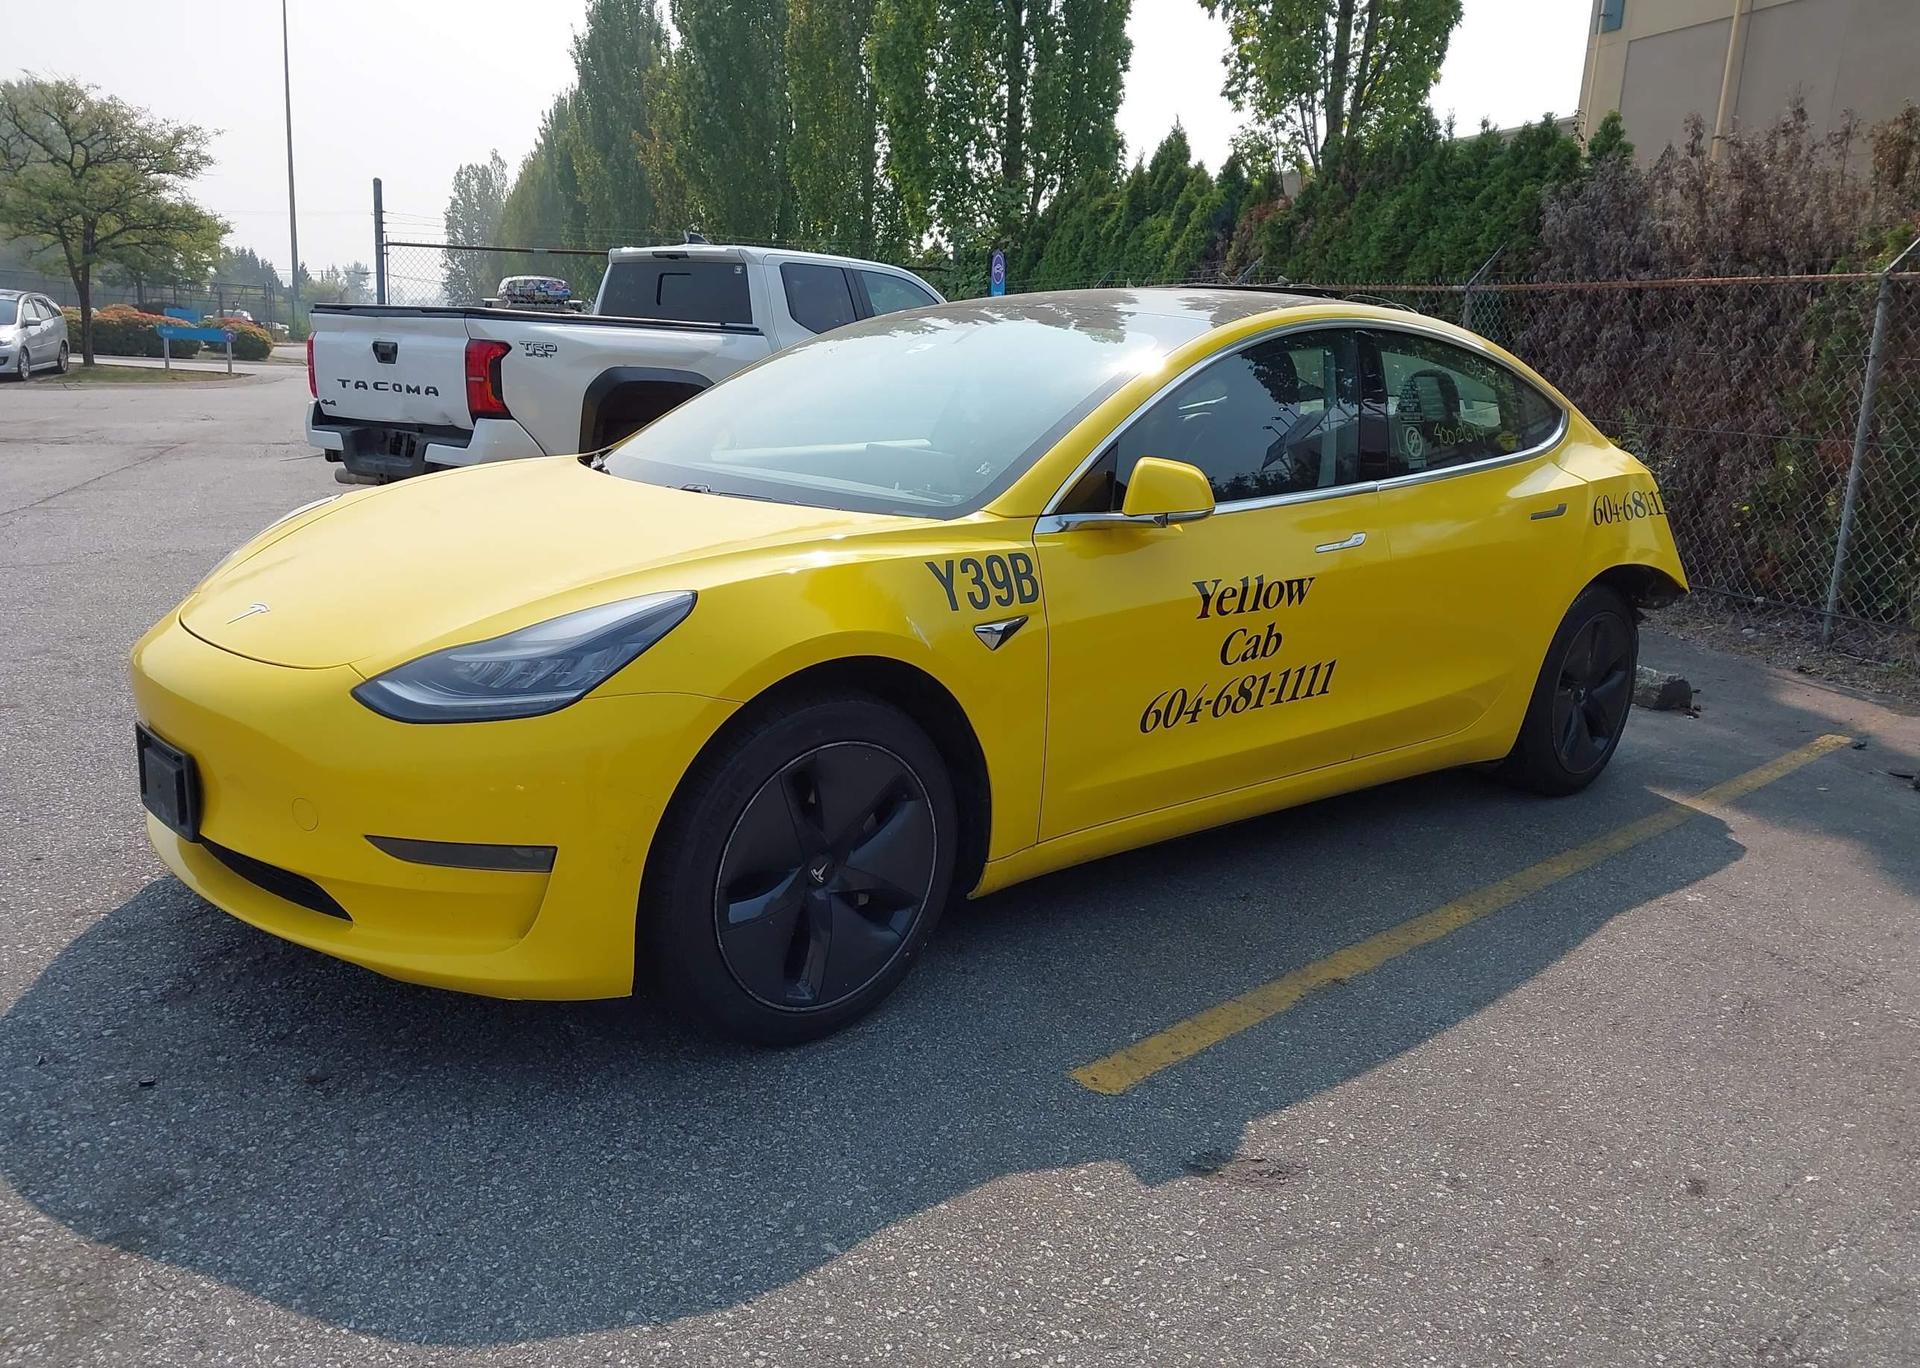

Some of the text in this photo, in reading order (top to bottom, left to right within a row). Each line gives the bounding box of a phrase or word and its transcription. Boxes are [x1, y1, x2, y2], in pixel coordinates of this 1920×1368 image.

[519, 340, 558, 354] TRD
[337, 378, 440, 397] TACOMA
[925, 552, 1039, 611] Y39B
[1192, 574, 1316, 619] Yellow
[1220, 622, 1283, 666] Cab
[1140, 659, 1337, 734] 604-681-1111
